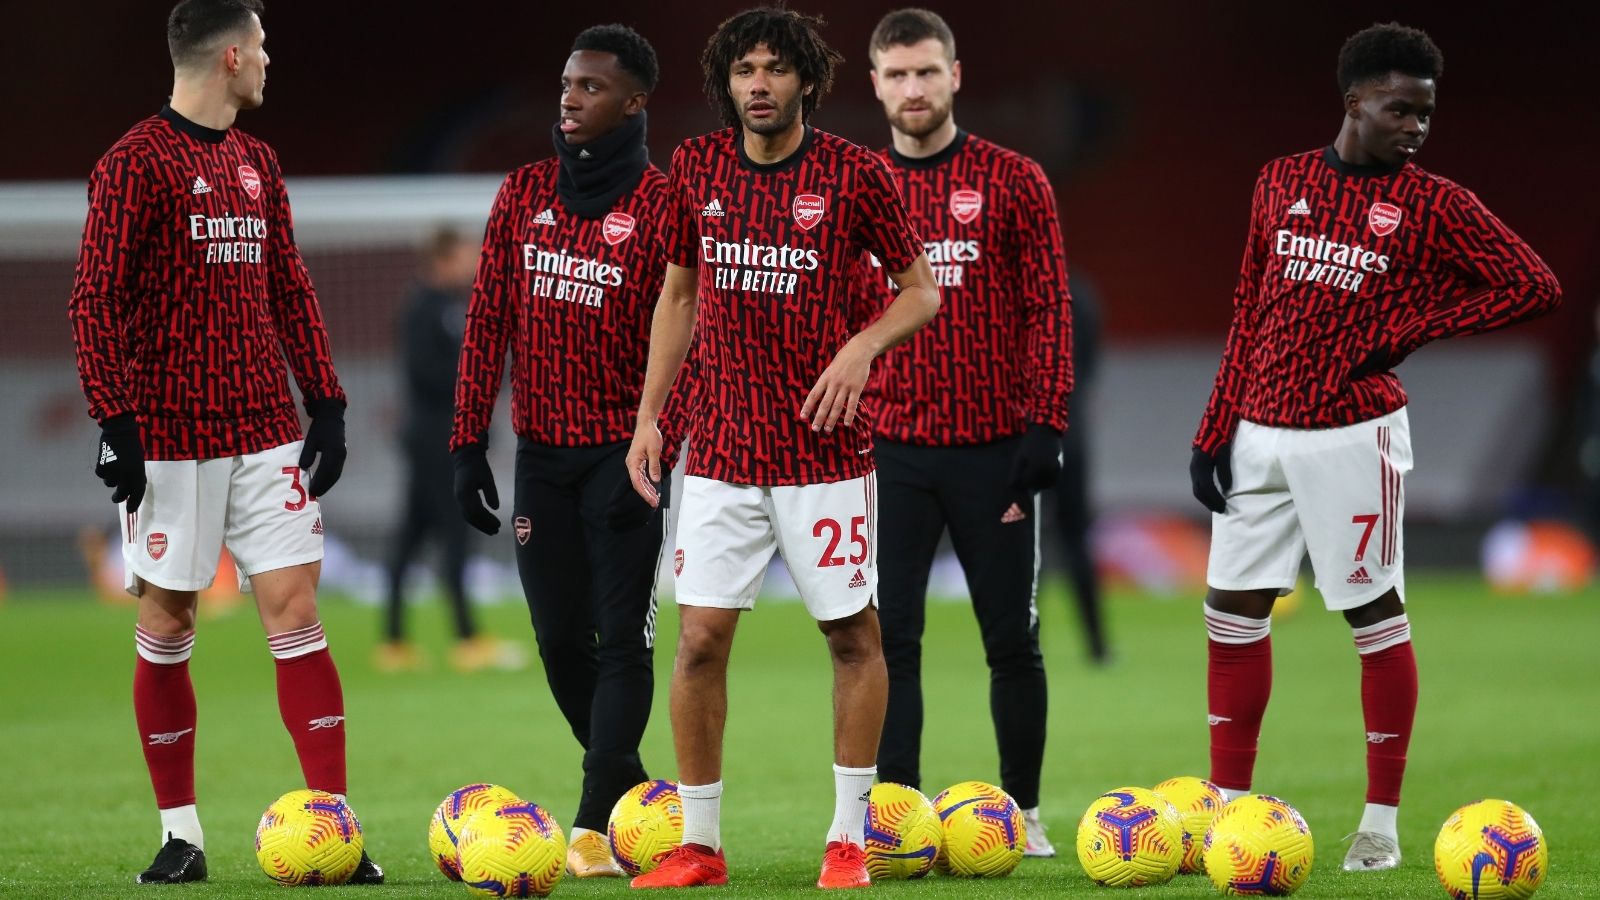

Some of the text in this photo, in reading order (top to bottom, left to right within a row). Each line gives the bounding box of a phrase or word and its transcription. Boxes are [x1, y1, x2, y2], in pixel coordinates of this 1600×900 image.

[193, 186, 212, 195] adidas
[798, 199, 820, 207] Arsenal
[189, 211, 267, 240] Emirates
[532, 217, 557, 226] adidas
[702, 209, 725, 217] adidas
[1375, 207, 1397, 217] Arsenal
[523, 243, 623, 287] Emirates
[701, 236, 819, 271] Emirates
[923, 238, 980, 262] ates
[1276, 229, 1390, 274] Emirates
[715, 267, 798, 295] FLY BETTER
[1283, 259, 1365, 292] FLY BETTER
[533, 275, 604, 308] FLY BETTER
[281, 466, 318, 512] 3
[812, 515, 868, 568] 25
[1352, 513, 1380, 562] 7
